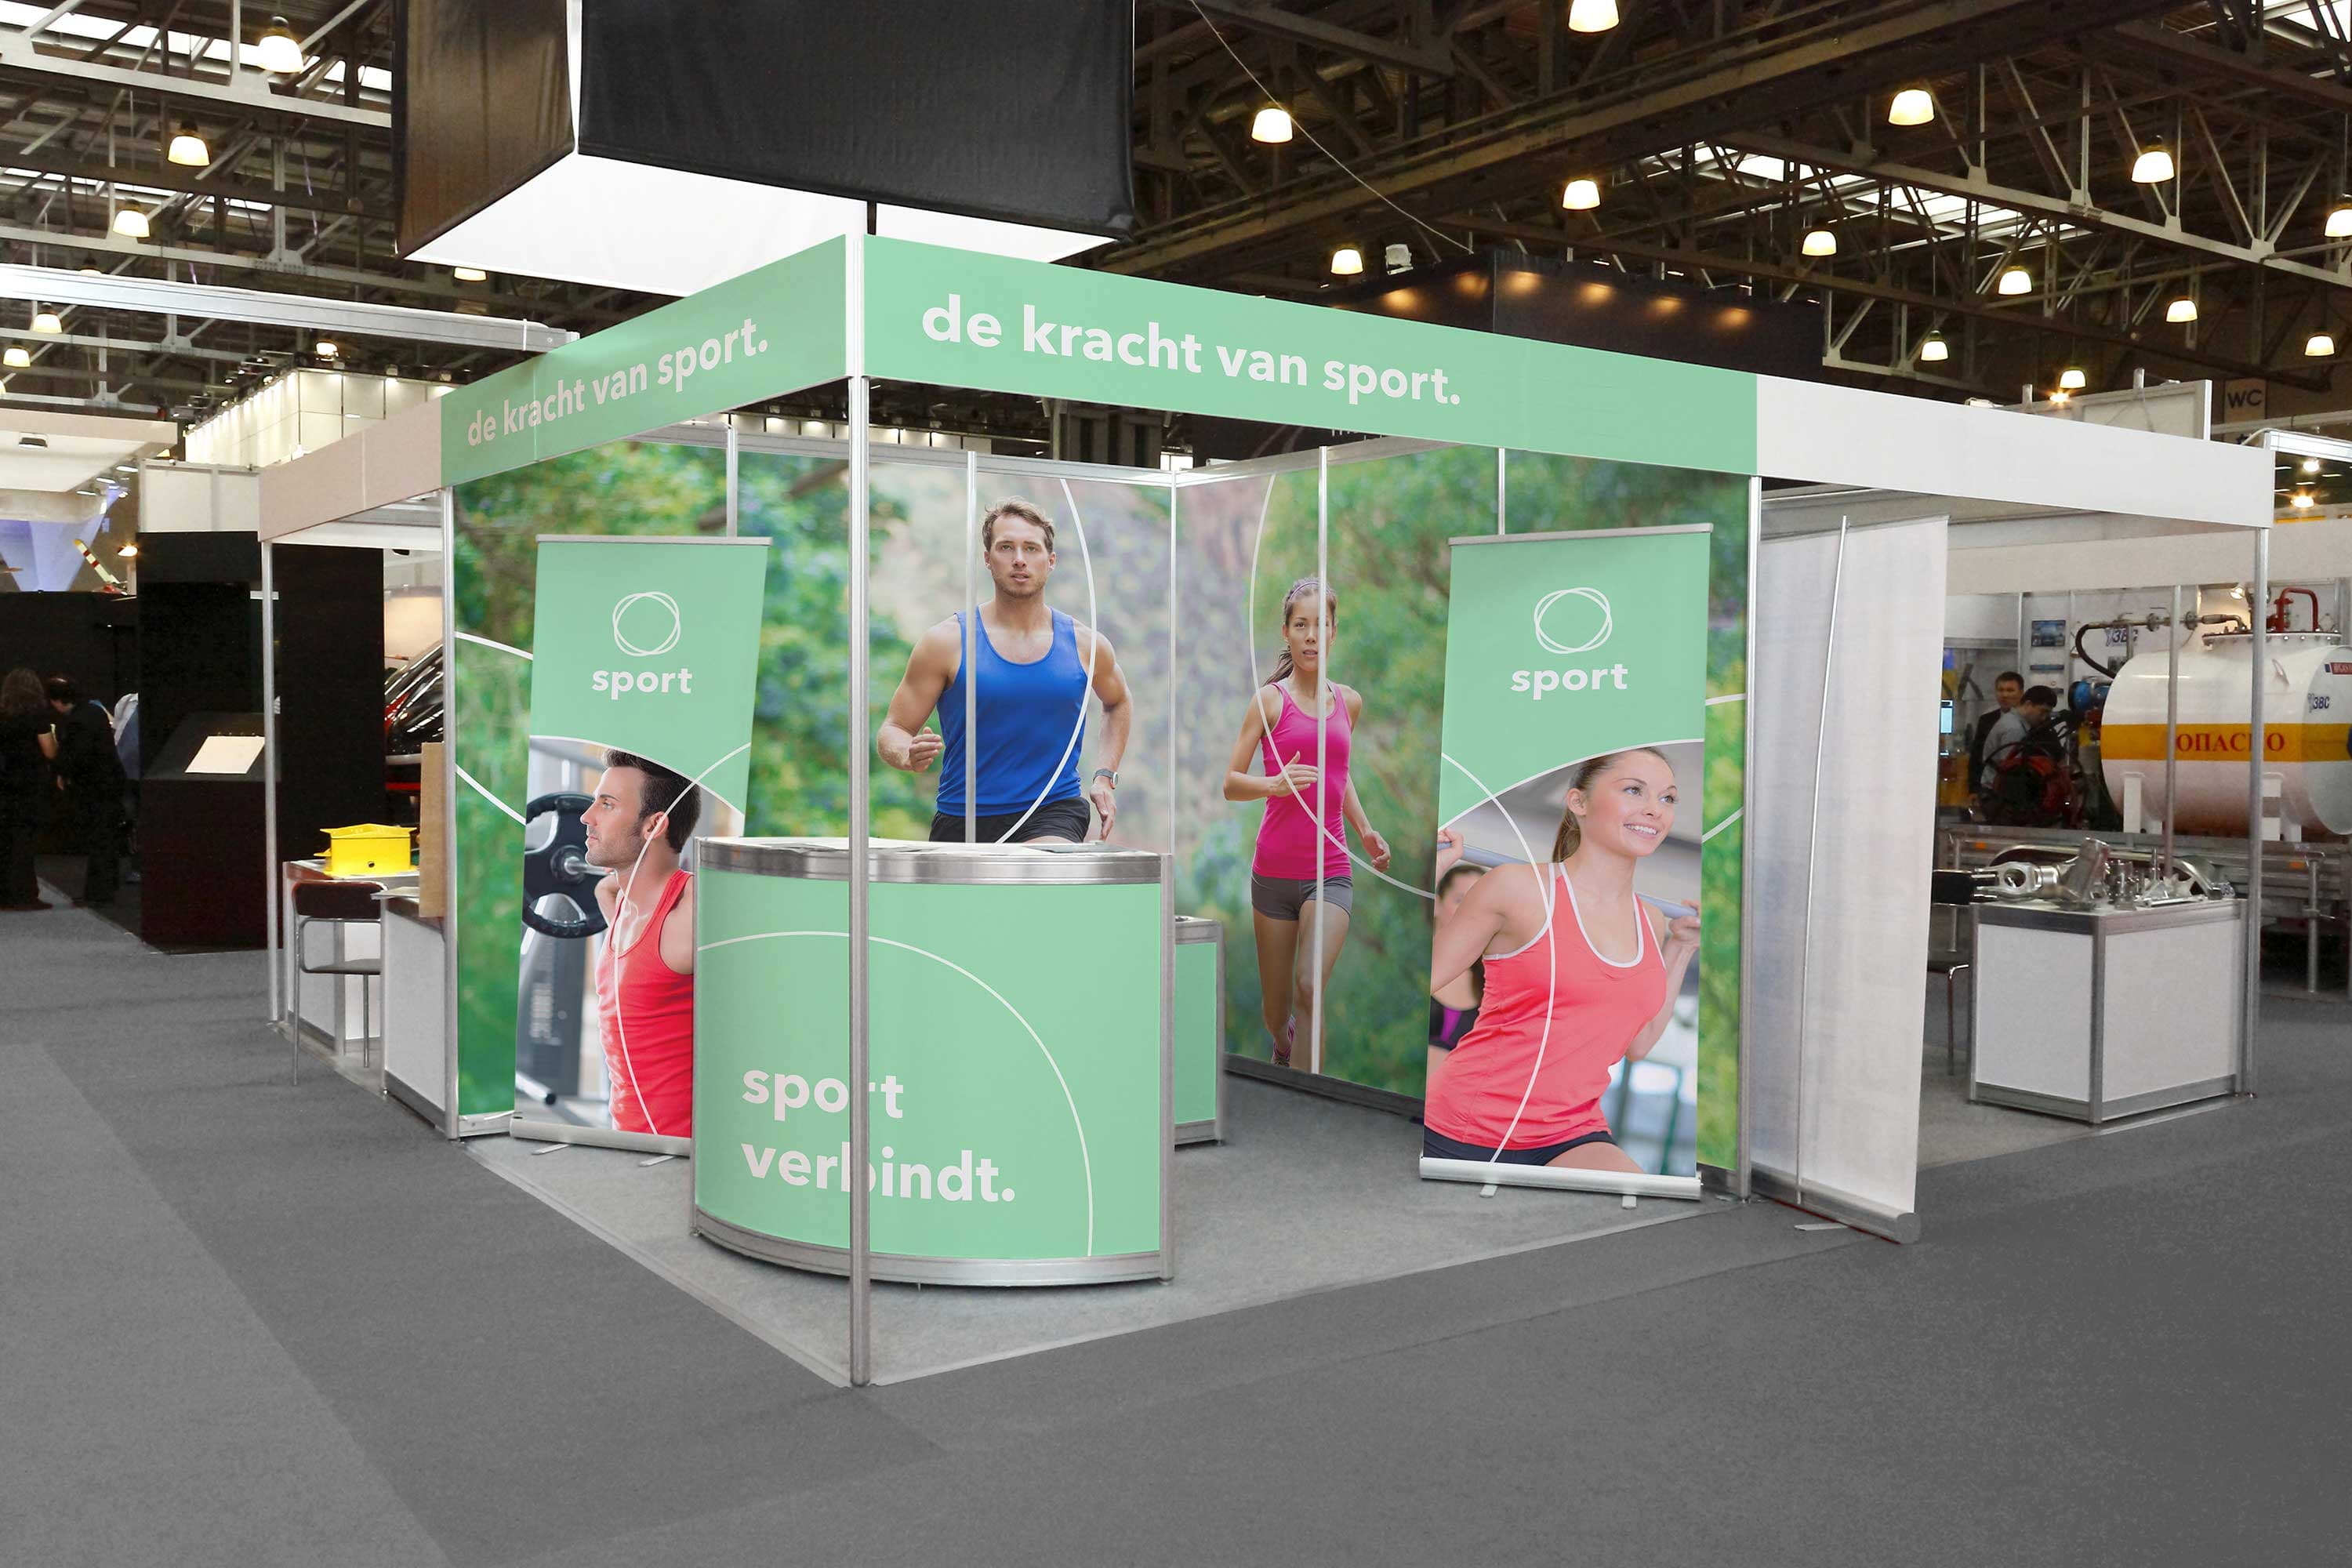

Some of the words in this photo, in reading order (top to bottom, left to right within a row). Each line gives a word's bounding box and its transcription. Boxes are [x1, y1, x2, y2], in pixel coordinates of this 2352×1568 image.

[921, 292, 1003, 348] de
[1022, 303, 1203, 374] kracht
[1216, 344, 1308, 387] van
[1321, 359, 1462, 407] sport.
[467, 409, 496, 446] de
[503, 376, 586, 435] kracht
[592, 362, 648, 405] van
[657, 318, 768, 393] sport.
[2227, 389, 2262, 408] WC
[591, 667, 693, 700] sport
[1510, 662, 1629, 701] sport
[2176, 732, 2285, 752] ОПАСО
[741, 1141, 1016, 1204] verbindt.
